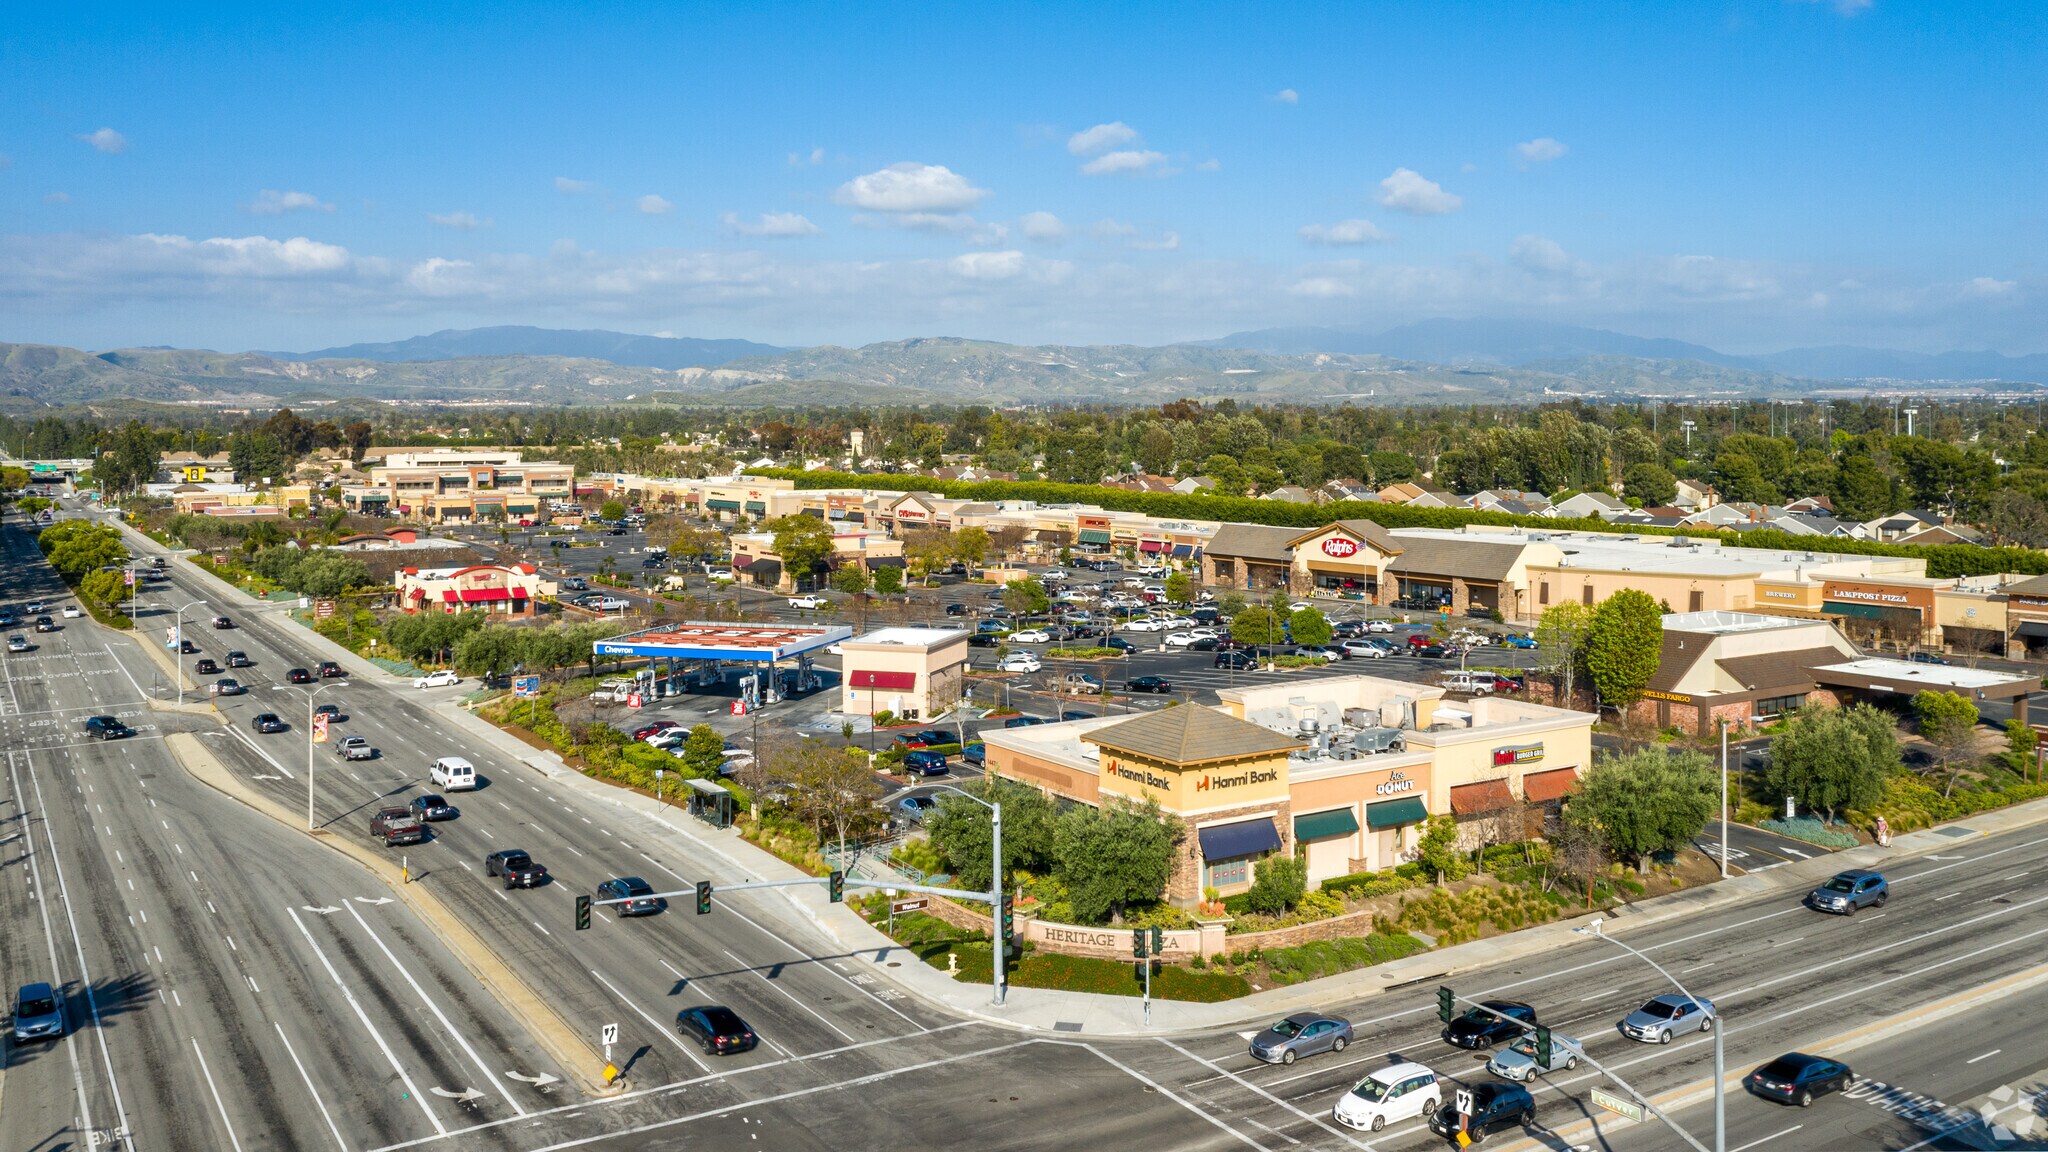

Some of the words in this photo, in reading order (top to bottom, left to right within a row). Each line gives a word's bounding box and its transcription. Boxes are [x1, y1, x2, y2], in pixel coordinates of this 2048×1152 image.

[1325, 540, 1354, 556] Ralphs
[1765, 591, 1796, 599] BREWERY
[1834, 590, 1879, 601] LAMPPOST
[1881, 594, 1908, 603] PIZZA
[604, 645, 634, 654] Chevron
[1641, 690, 1666, 699] WELLS
[1666, 693, 1691, 703] FARGO
[1516, 751, 1533, 760] BURGER
[1117, 764, 1146, 784] Hanmi
[1146, 773, 1170, 791] Bank
[1212, 771, 1248, 790] Hanmi
[1250, 768, 1278, 784] Bank
[1390, 770, 1406, 781] Ace
[1376, 780, 1415, 795] DONUT
[902, 902, 920, 911] Walnut
[1045, 928, 1115, 947] HERITAGE
[1599, 1096, 1633, 1115] Culver
